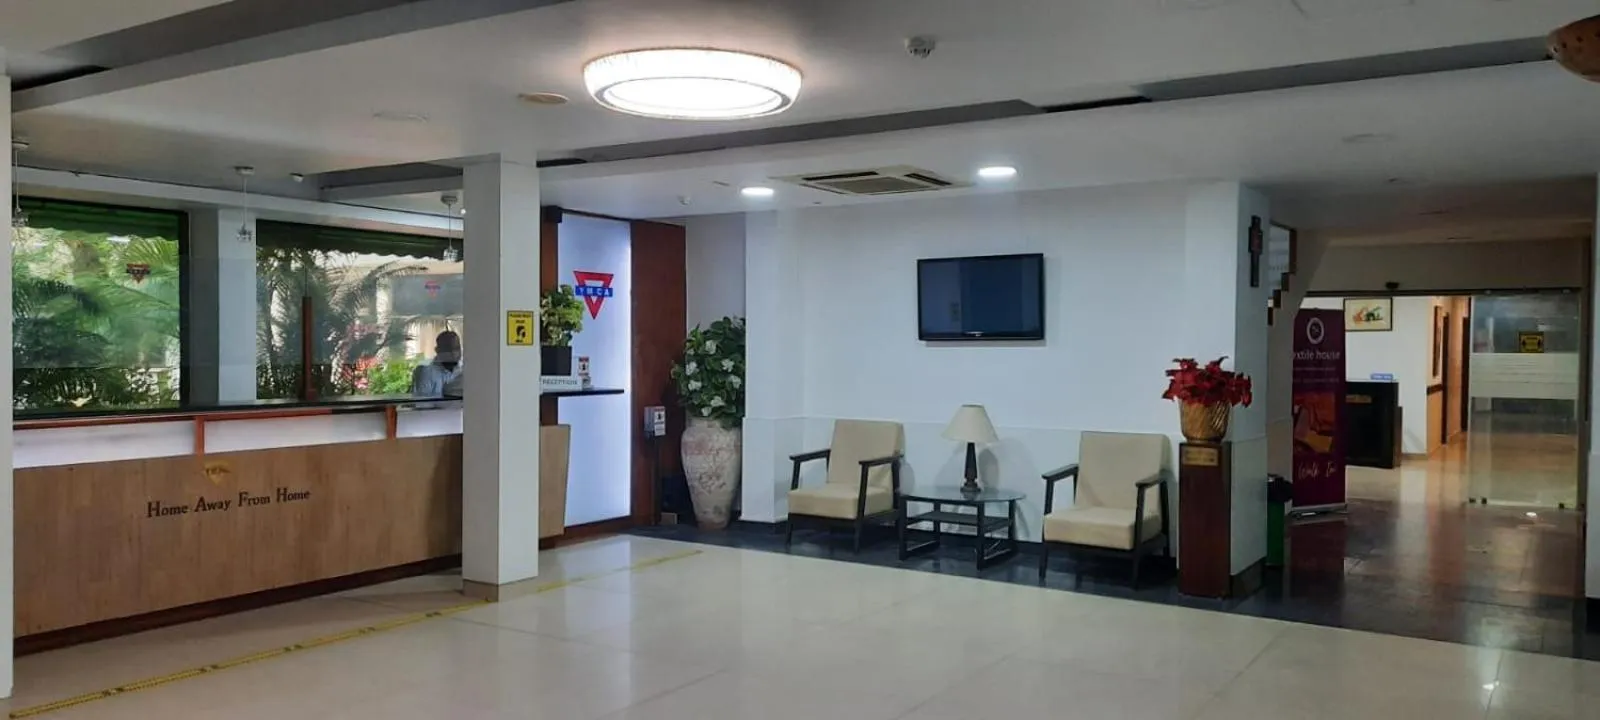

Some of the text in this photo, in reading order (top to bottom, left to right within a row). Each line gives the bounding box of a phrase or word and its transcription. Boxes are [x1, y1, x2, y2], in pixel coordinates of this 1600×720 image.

[147, 486, 311, 518] Home Away From Home
